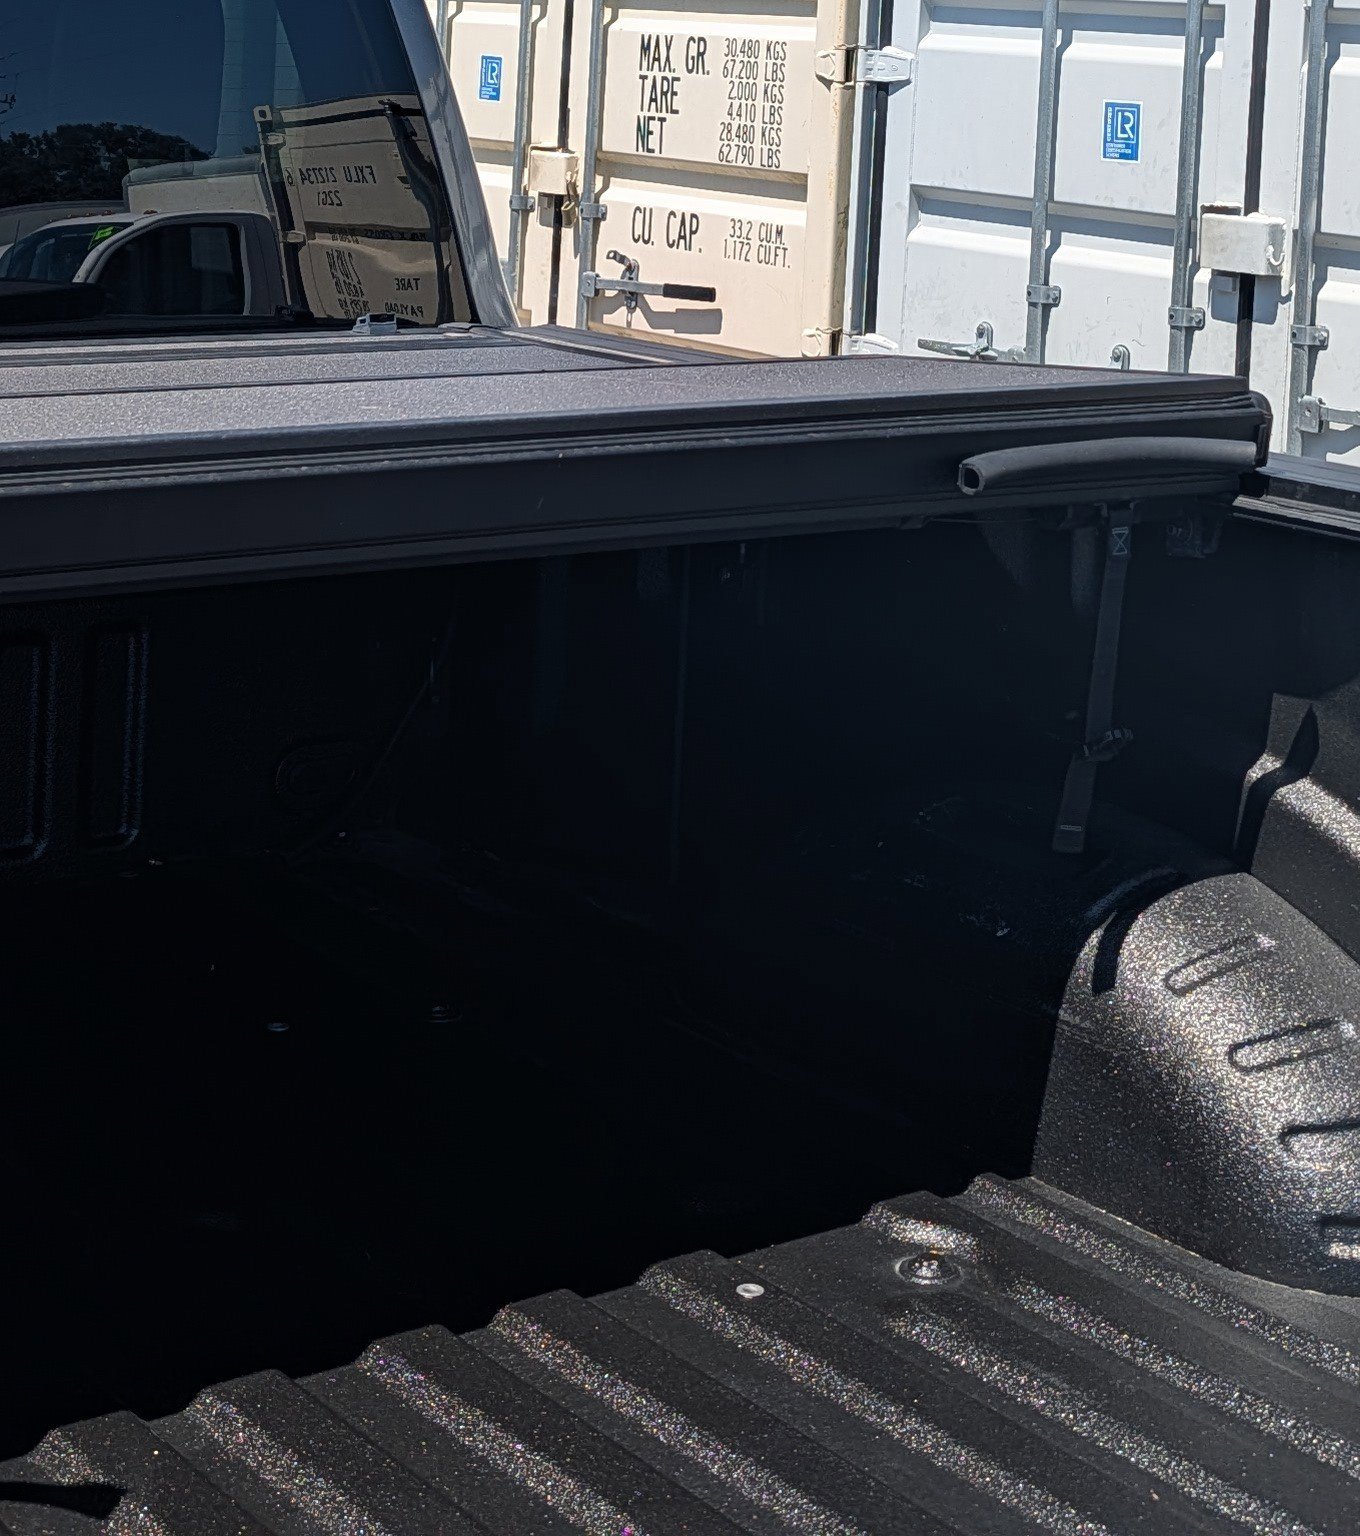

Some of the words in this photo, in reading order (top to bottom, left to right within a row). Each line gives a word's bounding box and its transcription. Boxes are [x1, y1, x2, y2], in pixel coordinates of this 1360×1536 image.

[639, 33, 676, 73] MAX.
[685, 36, 710, 75] GR.
[765, 40, 787, 61] KGS
[764, 62, 786, 82] LBS
[639, 74, 681, 114] TARE
[762, 83, 785, 104] KGS
[761, 105, 783, 126] LBS
[1117, 111, 1134, 139] LR
[635, 115, 667, 154] NET
[760, 126, 782, 147] KGS
[760, 147, 781, 168] LBS
[631, 206, 655, 246] CU.
[666, 210, 702, 253] CAP.
[729, 218, 753, 241] 33.2
[758, 222, 786, 245] CU.M.
